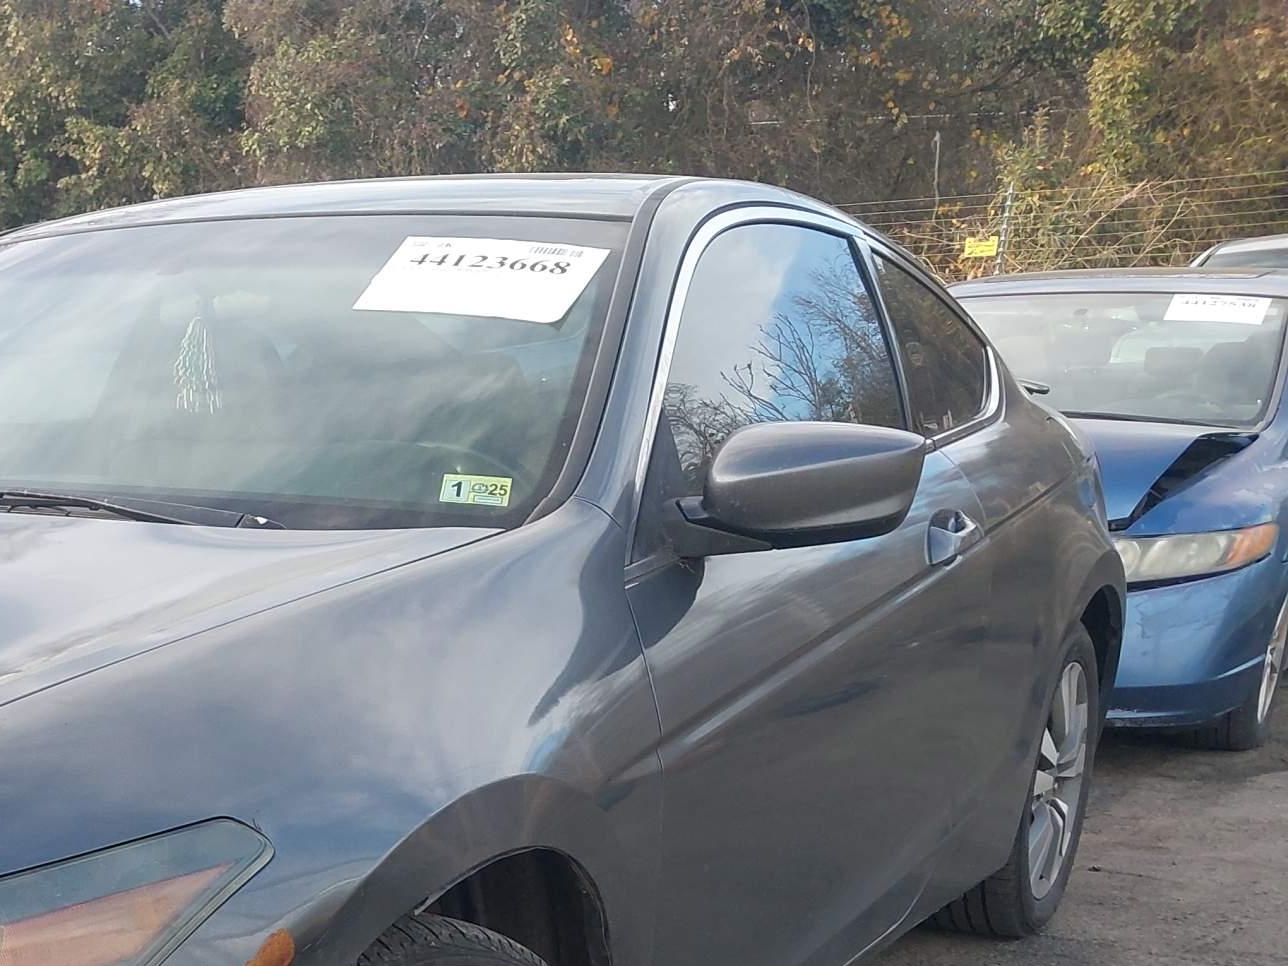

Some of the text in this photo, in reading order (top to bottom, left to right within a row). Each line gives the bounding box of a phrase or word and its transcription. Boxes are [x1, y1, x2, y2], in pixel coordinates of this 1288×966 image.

[410, 253, 571, 274] 44123668
[451, 480, 509, 497] 1 25
